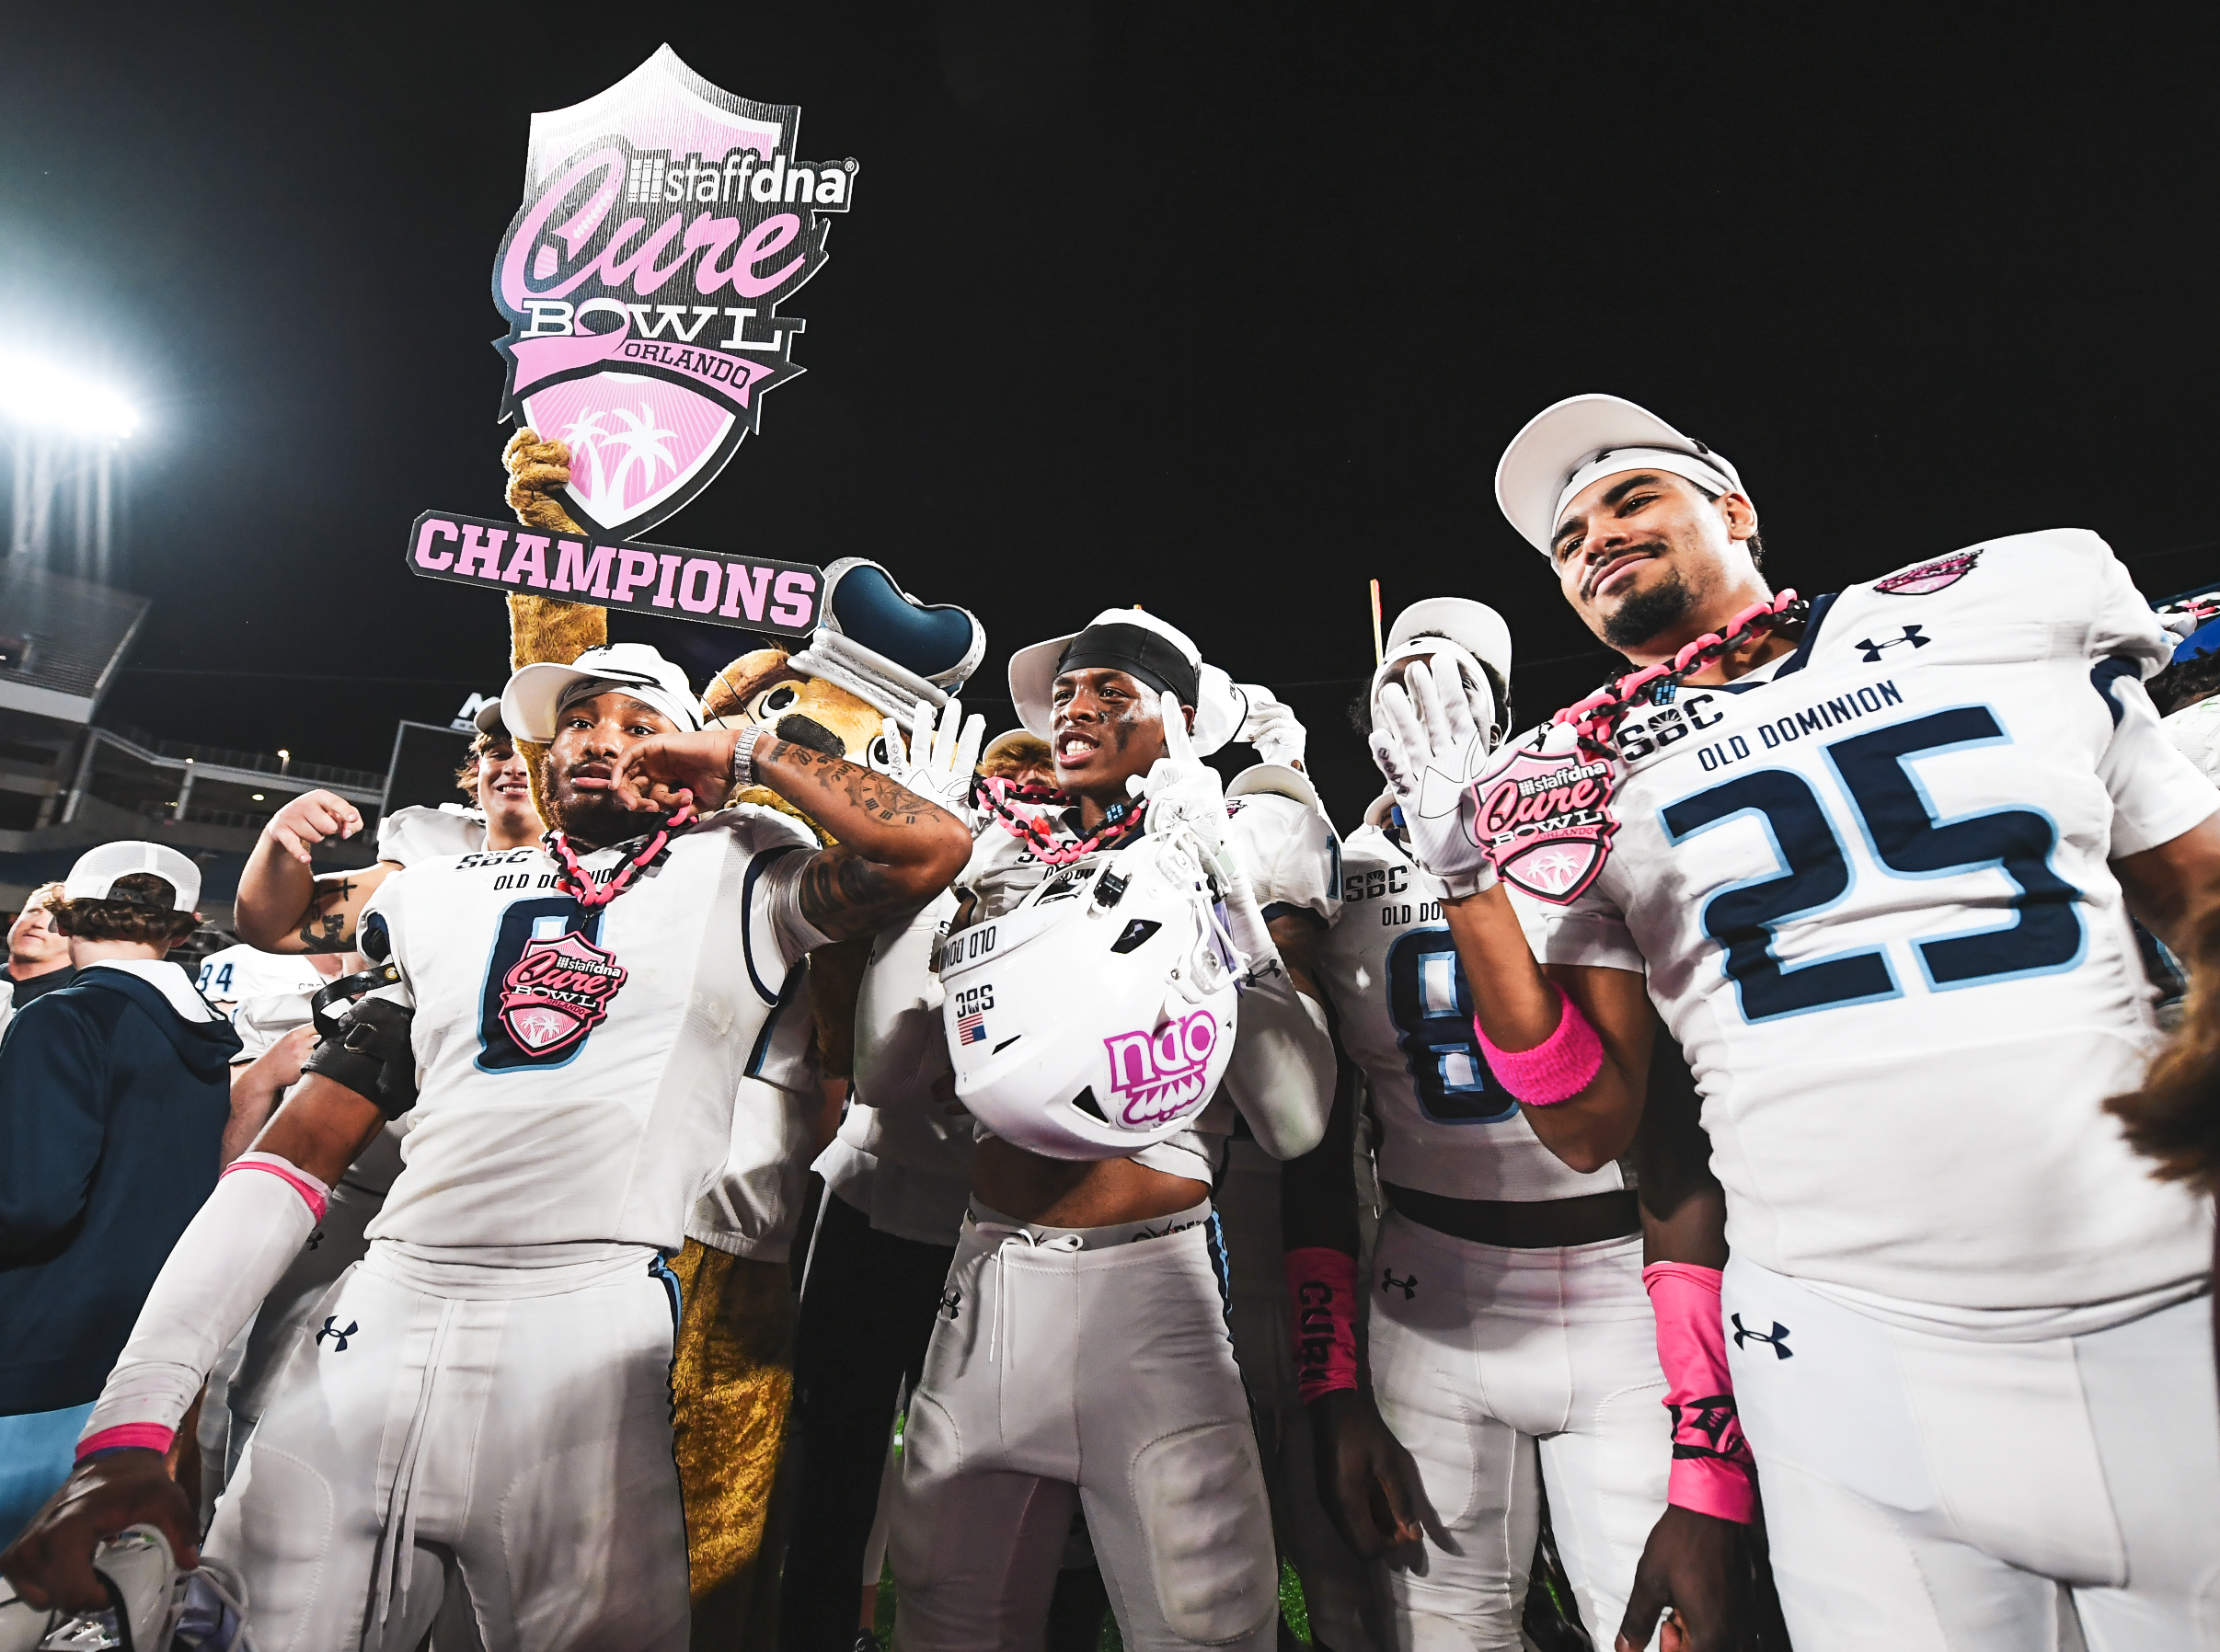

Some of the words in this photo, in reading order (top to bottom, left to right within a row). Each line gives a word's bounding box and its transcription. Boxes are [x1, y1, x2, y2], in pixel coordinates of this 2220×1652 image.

[501, 145, 805, 314] Cure
[520, 298, 783, 352] BOWL
[624, 341, 752, 389] ORLANDO
[414, 518, 818, 628] CHAMPIONS
[1616, 694, 1724, 762] SBC
[1697, 734, 1750, 772] OLD
[1757, 679, 1904, 749] DOMINION
[1477, 781, 1600, 842] Cure
[1490, 809, 1603, 848] BOWL
[454, 850, 534, 869] SBC
[1656, 702, 2088, 1025] 25
[493, 874, 530, 890] OLD
[1345, 865, 1409, 902] SBC
[1382, 904, 1411, 926] OLD
[969, 925, 996, 959] OLD
[507, 951, 607, 994] Cure
[568, 959, 622, 978] staffdna
[512, 984, 597, 1008] BOWL
[546, 999, 585, 1015] ORLANDO
[955, 983, 995, 1018] SBC
[1386, 926, 1520, 1124] 8
[1105, 1011, 1216, 1092] ODU
